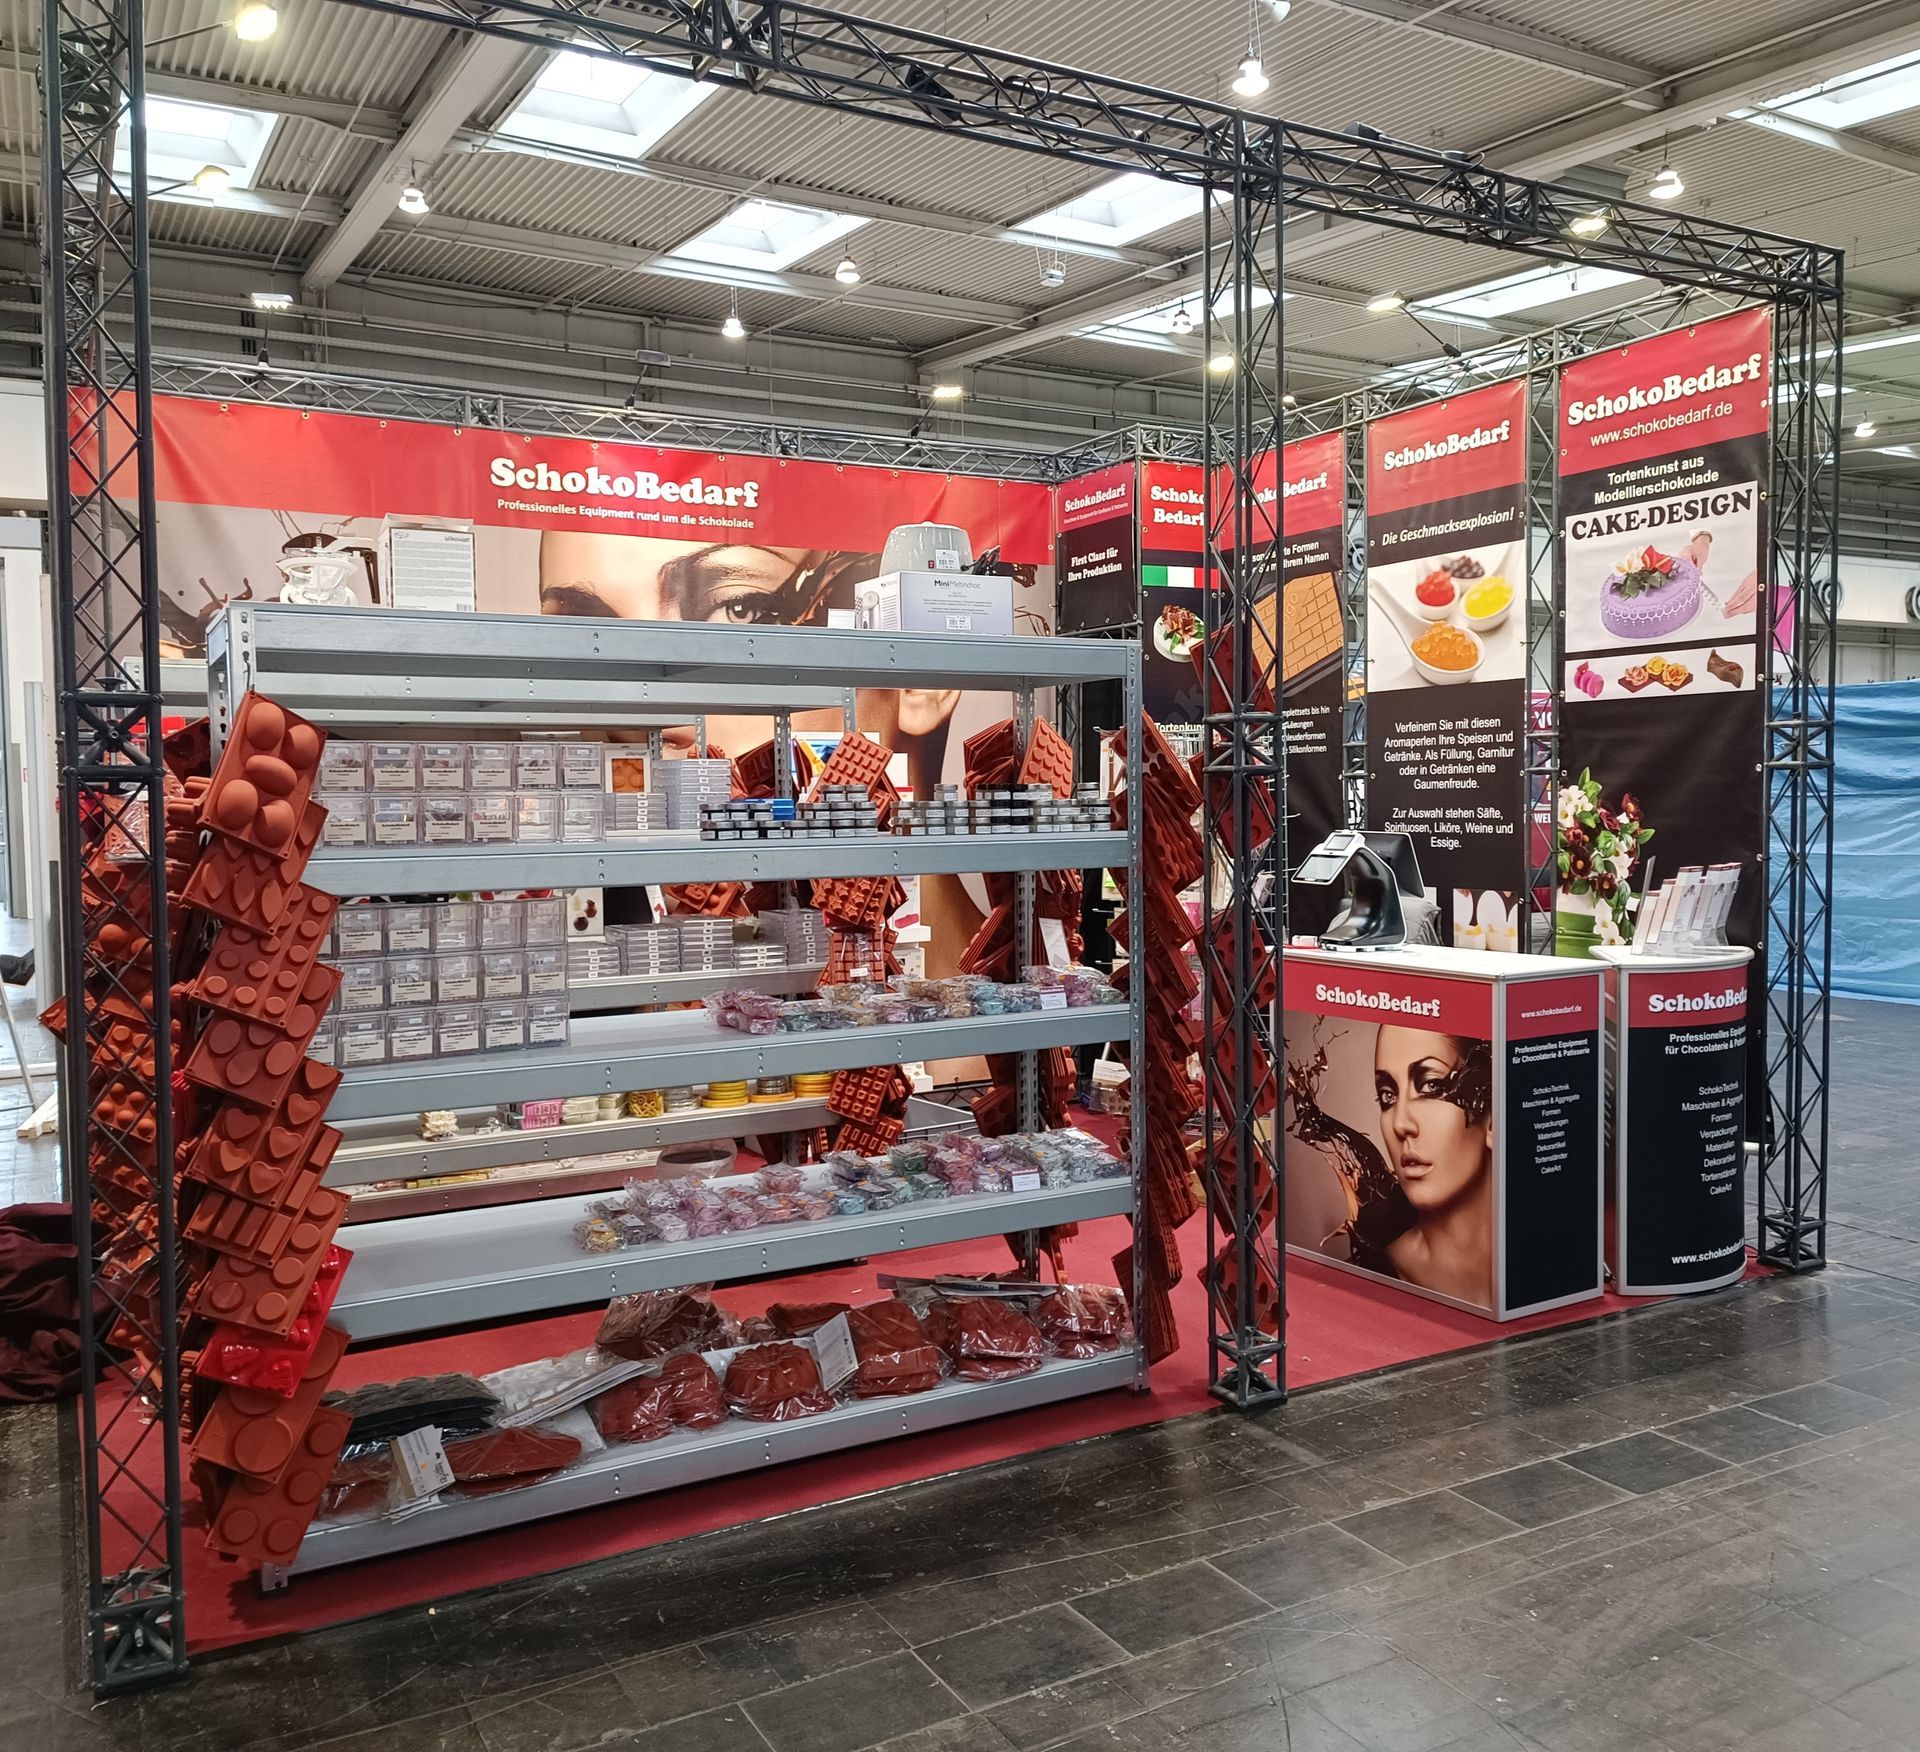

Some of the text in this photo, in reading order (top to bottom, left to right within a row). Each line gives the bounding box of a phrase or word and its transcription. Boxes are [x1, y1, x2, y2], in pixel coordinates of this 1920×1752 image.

[1568, 353, 1762, 426] SchokoBedarf
[1591, 401, 1733, 447] www.schokobedarf.de
[1384, 420, 1511, 471] SchokoBedarf
[1608, 455, 1705, 486] Tortenkunst aus
[490, 457, 760, 508] SchokoBedarf
[1594, 469, 1720, 505] Modellierschokolade
[1064, 483, 1127, 513] SchokoBedarf
[497, 499, 755, 529] Professionelles Equipment rund um die Schokolade
[1571, 488, 1753, 541] CAKE-DESIGN
[1382, 507, 1515, 546] Die Geschmacksexplosion!
[1292, 541, 1319, 554] Formen
[1071, 547, 1119, 567] First Class für
[1304, 552, 1330, 565] Namen
[1067, 562, 1123, 582] Ihre Produktion
[1311, 705, 1320, 715] bis
[1320, 705, 1331, 714] hin
[1395, 717, 1501, 733] Verfeinern Sie mit diesen
[1384, 730, 1514, 749] Aromaperlen Ihre Speisen und
[1384, 746, 1515, 762] Getränke. Als Füllung, Garnitur
[1399, 762, 1496, 776] oder in Getränken eine
[1414, 778, 1480, 790] Gaumenfreude.
[1392, 807, 1503, 820] Zur Auswahl stehen Säfte,
[1384, 821, 1514, 835] Spirituosen, Liköre, Weine und
[1430, 836, 1462, 850] Essige.
[1315, 983, 1441, 1018] SchokoBedarf
[1669, 1030, 1729, 1043] Professionelles
[1514, 1038, 1588, 1055] Professionelles Equipment
[1664, 1046, 1679, 1055] für
[1681, 1041, 1729, 1054] Chocolaterie
[1729, 1040, 1734, 1049] &
[1512, 1047, 1590, 1065] für Chocolaterie & Patisserie
[1682, 1100, 1720, 1111] Maschinen
[1721, 1098, 1726, 1107] &
[1711, 1112, 1733, 1123] Formen
